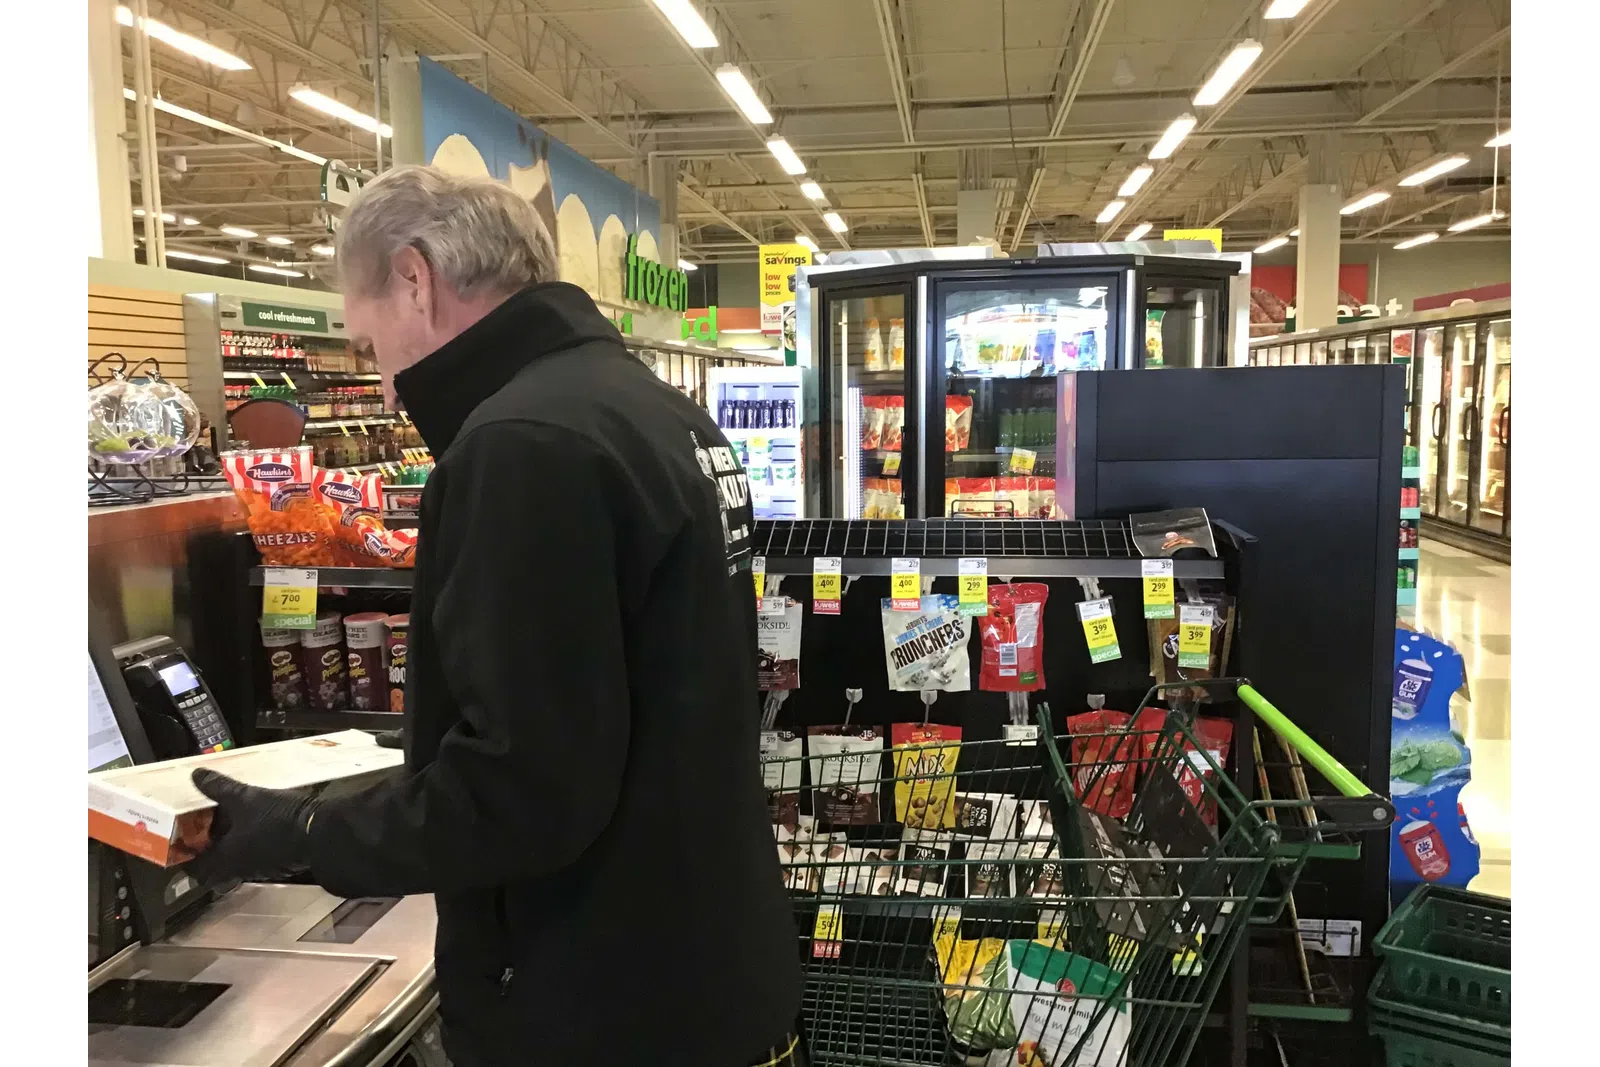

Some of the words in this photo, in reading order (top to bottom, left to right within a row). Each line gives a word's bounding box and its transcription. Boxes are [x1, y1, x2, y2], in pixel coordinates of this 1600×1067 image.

[765, 252, 806, 266] savings
[624, 232, 688, 312] frozen
[765, 273, 781, 281] low
[765, 282, 781, 290] low
[258, 310, 274, 321] cool
[274, 311, 316, 325] refreshments
[707, 446, 737, 472] MEN
[249, 465, 293, 479] Hawkins
[273, 614, 313, 628] special
[890, 619, 965, 671] CRUNCHERS
[1398, 690, 1417, 700] GUM
